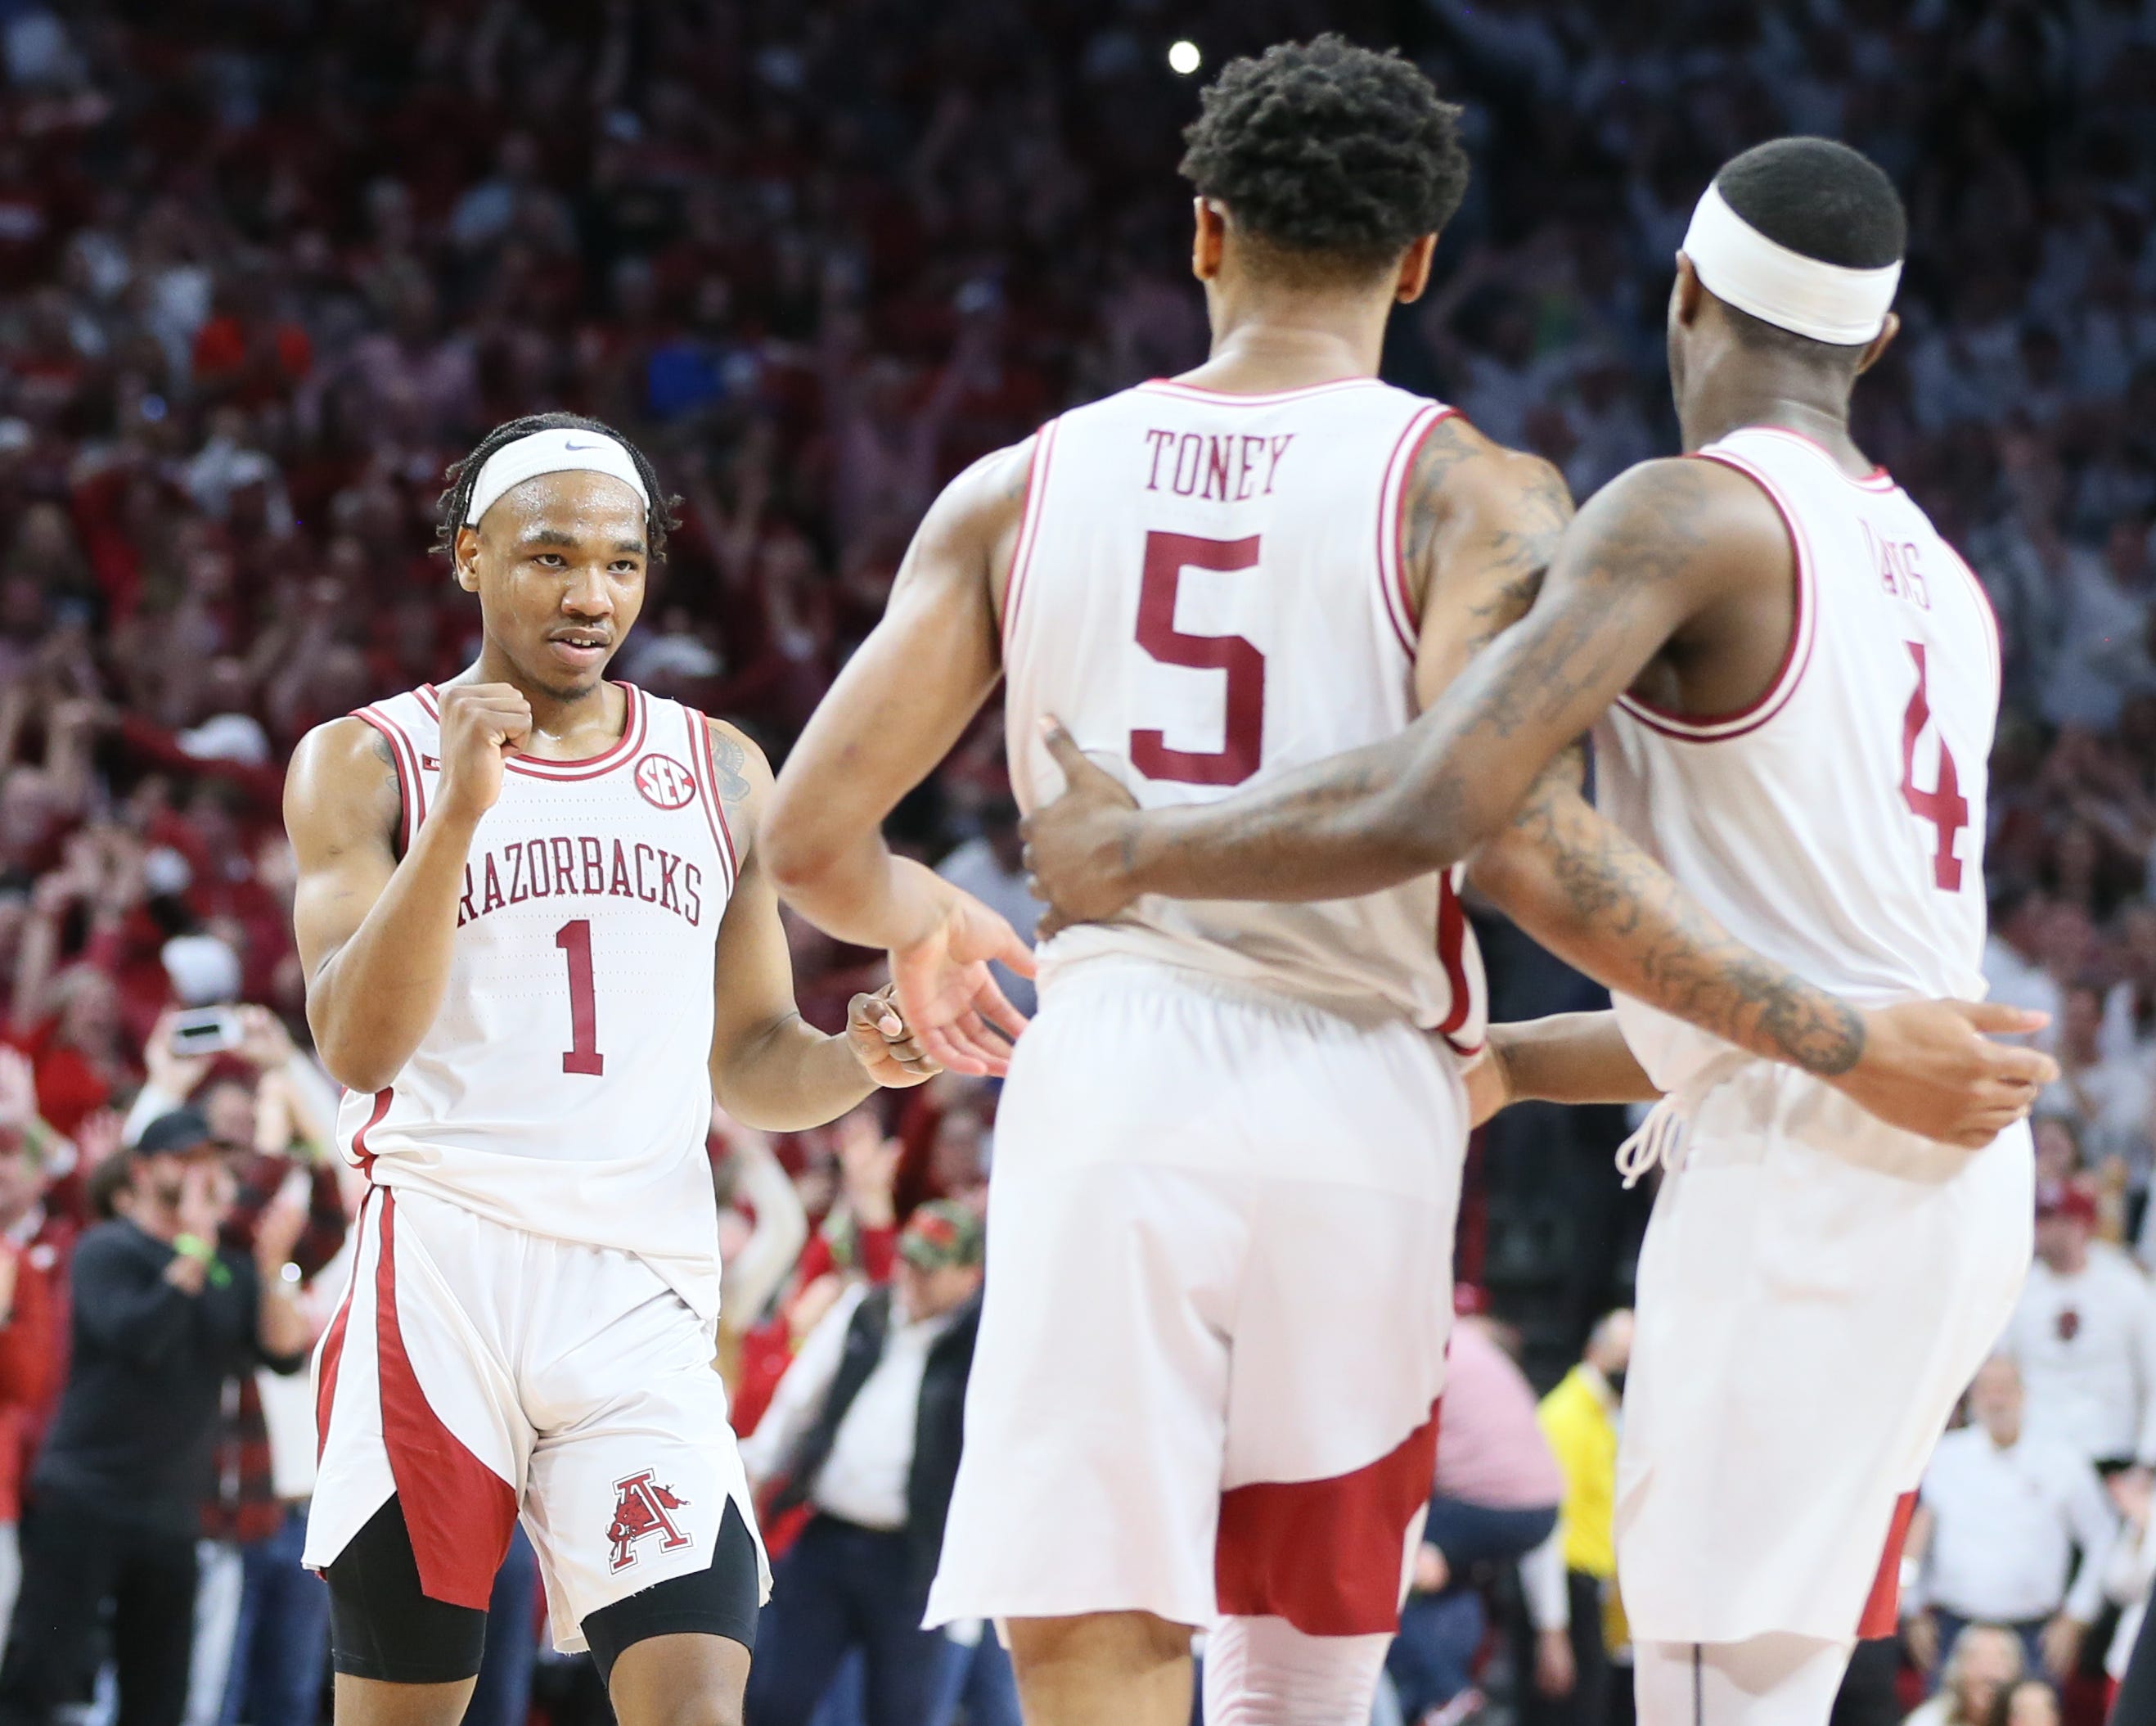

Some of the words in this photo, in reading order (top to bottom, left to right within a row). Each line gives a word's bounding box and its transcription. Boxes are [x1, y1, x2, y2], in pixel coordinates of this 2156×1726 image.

[1145, 428, 1296, 502] TONEY
[1130, 530, 1266, 787] 5
[637, 756, 695, 807] SEC
[1901, 640, 1969, 893] 4
[457, 836, 702, 928] RAZORBACKS
[556, 919, 604, 1076] 1
[609, 1467, 694, 1575] A
